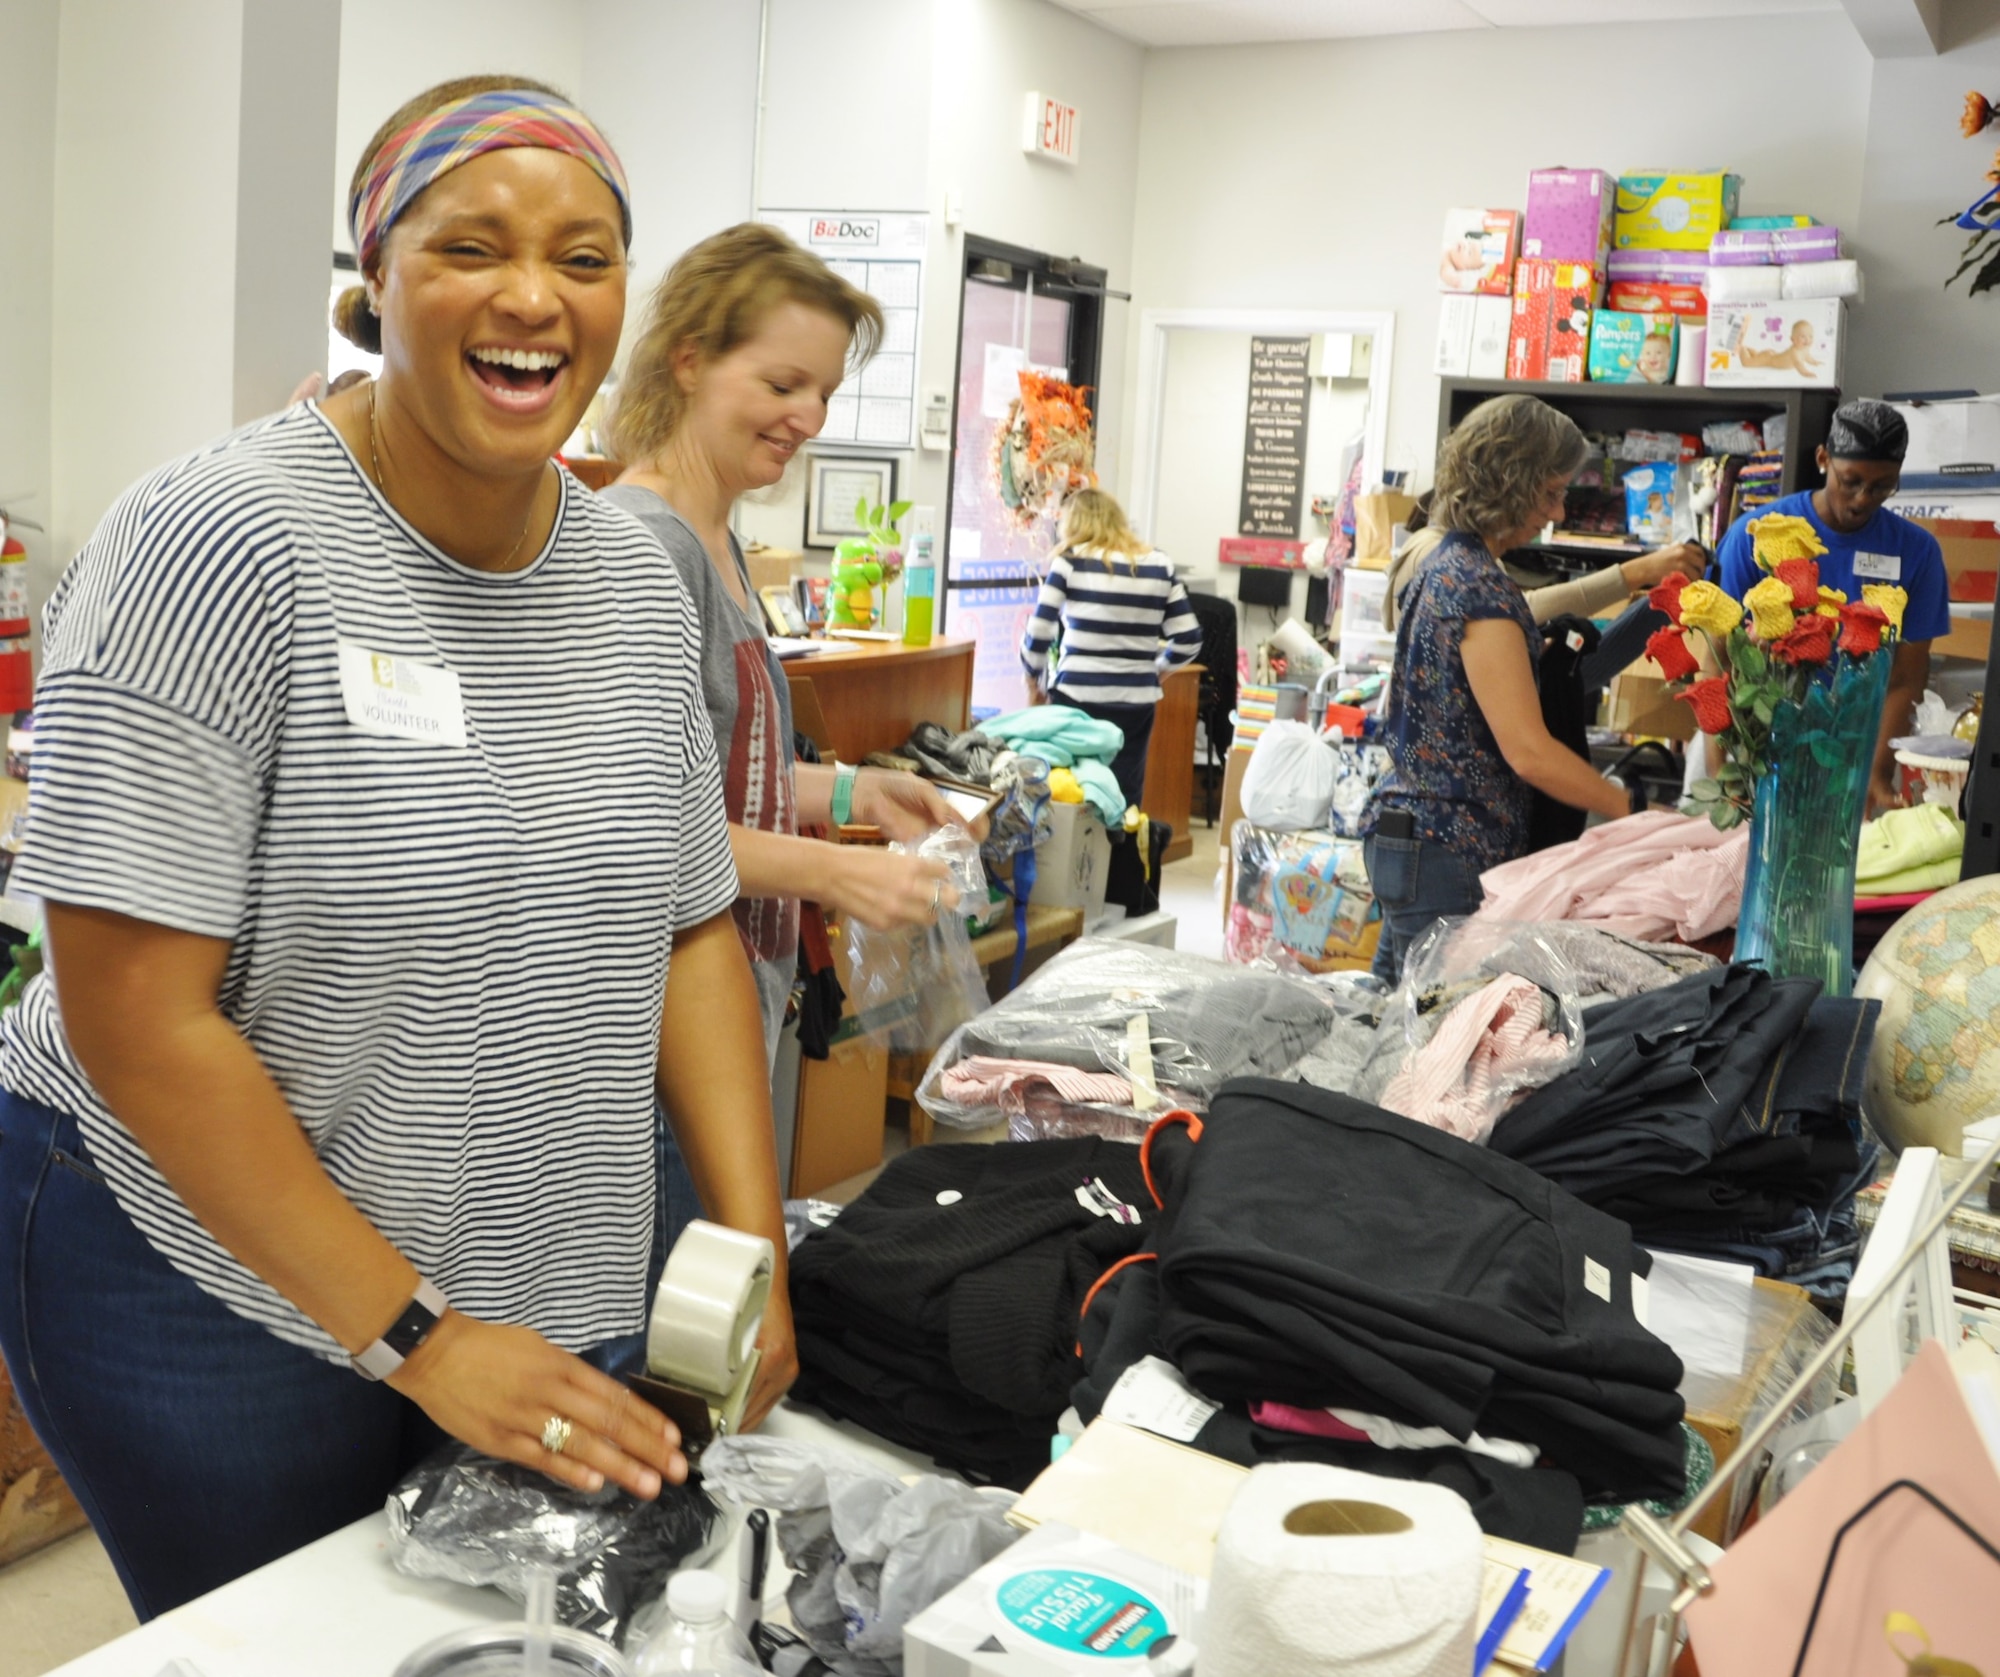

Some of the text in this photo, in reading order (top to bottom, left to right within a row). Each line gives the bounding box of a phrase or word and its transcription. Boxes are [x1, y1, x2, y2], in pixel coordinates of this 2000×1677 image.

[1044, 99, 1075, 156] EXIT
[815, 220, 874, 238] BizDoc
[1253, 340, 1309, 357] Be yourself
[1595, 323, 1641, 343] Pampers
[1254, 509, 1285, 521] LET GO
[362, 701, 441, 732] VOLUNTEER
[1017, 1575, 1095, 1631] TISSUE
[1048, 1590, 1105, 1632] Facial
[1089, 1604, 1150, 1653] KIRKLAND
